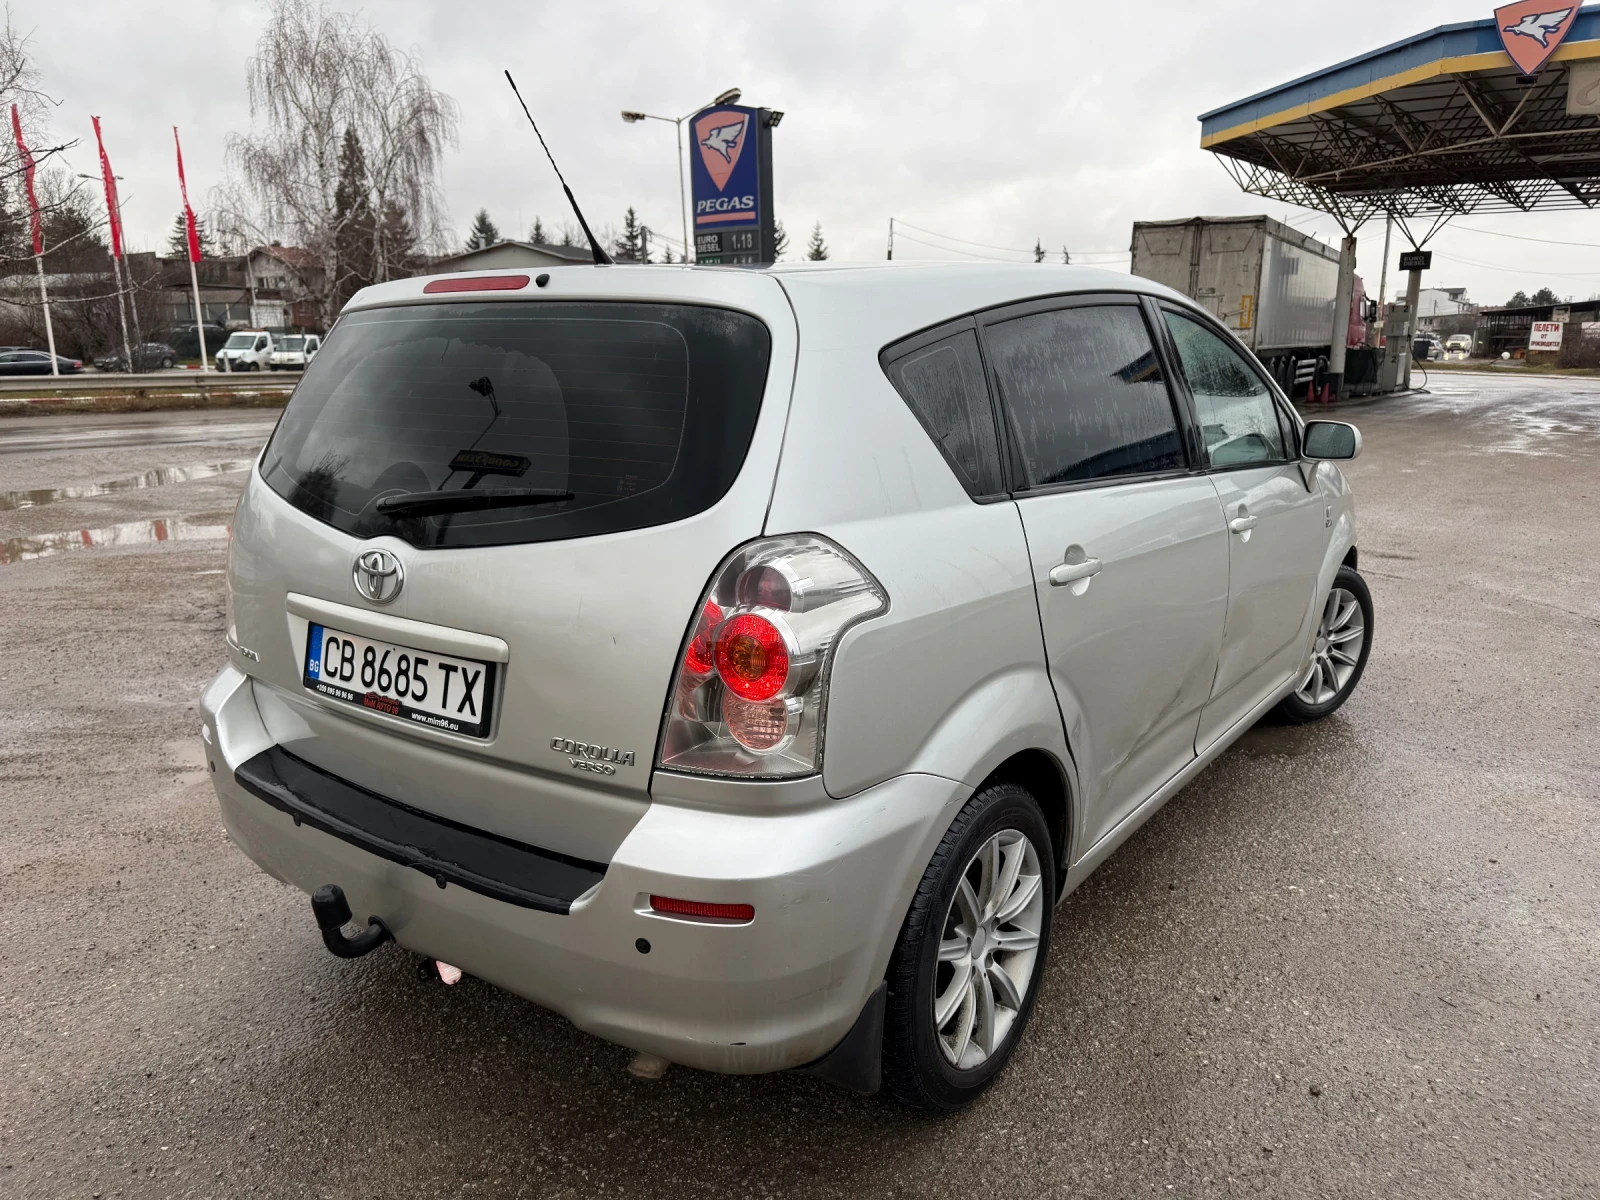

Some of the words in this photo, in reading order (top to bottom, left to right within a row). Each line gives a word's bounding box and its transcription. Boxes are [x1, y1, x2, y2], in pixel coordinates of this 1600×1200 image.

[696, 195, 754, 214] PEGAS
[697, 234, 718, 244] EURO
[732, 232, 753, 249] 1.18
[697, 243, 721, 253] DIESEL
[1533, 323, 1560, 332] ПЕЛЕТИ
[309, 659, 320, 673] BG
[324, 636, 355, 682] CB
[361, 645, 429, 702] 8685
[438, 662, 481, 717] TX
[316, 684, 327, 693] +359
[411, 712, 459, 731] www.mim96.eu
[550, 736, 635, 767] COROLLA
[568, 757, 616, 776] VERSO
